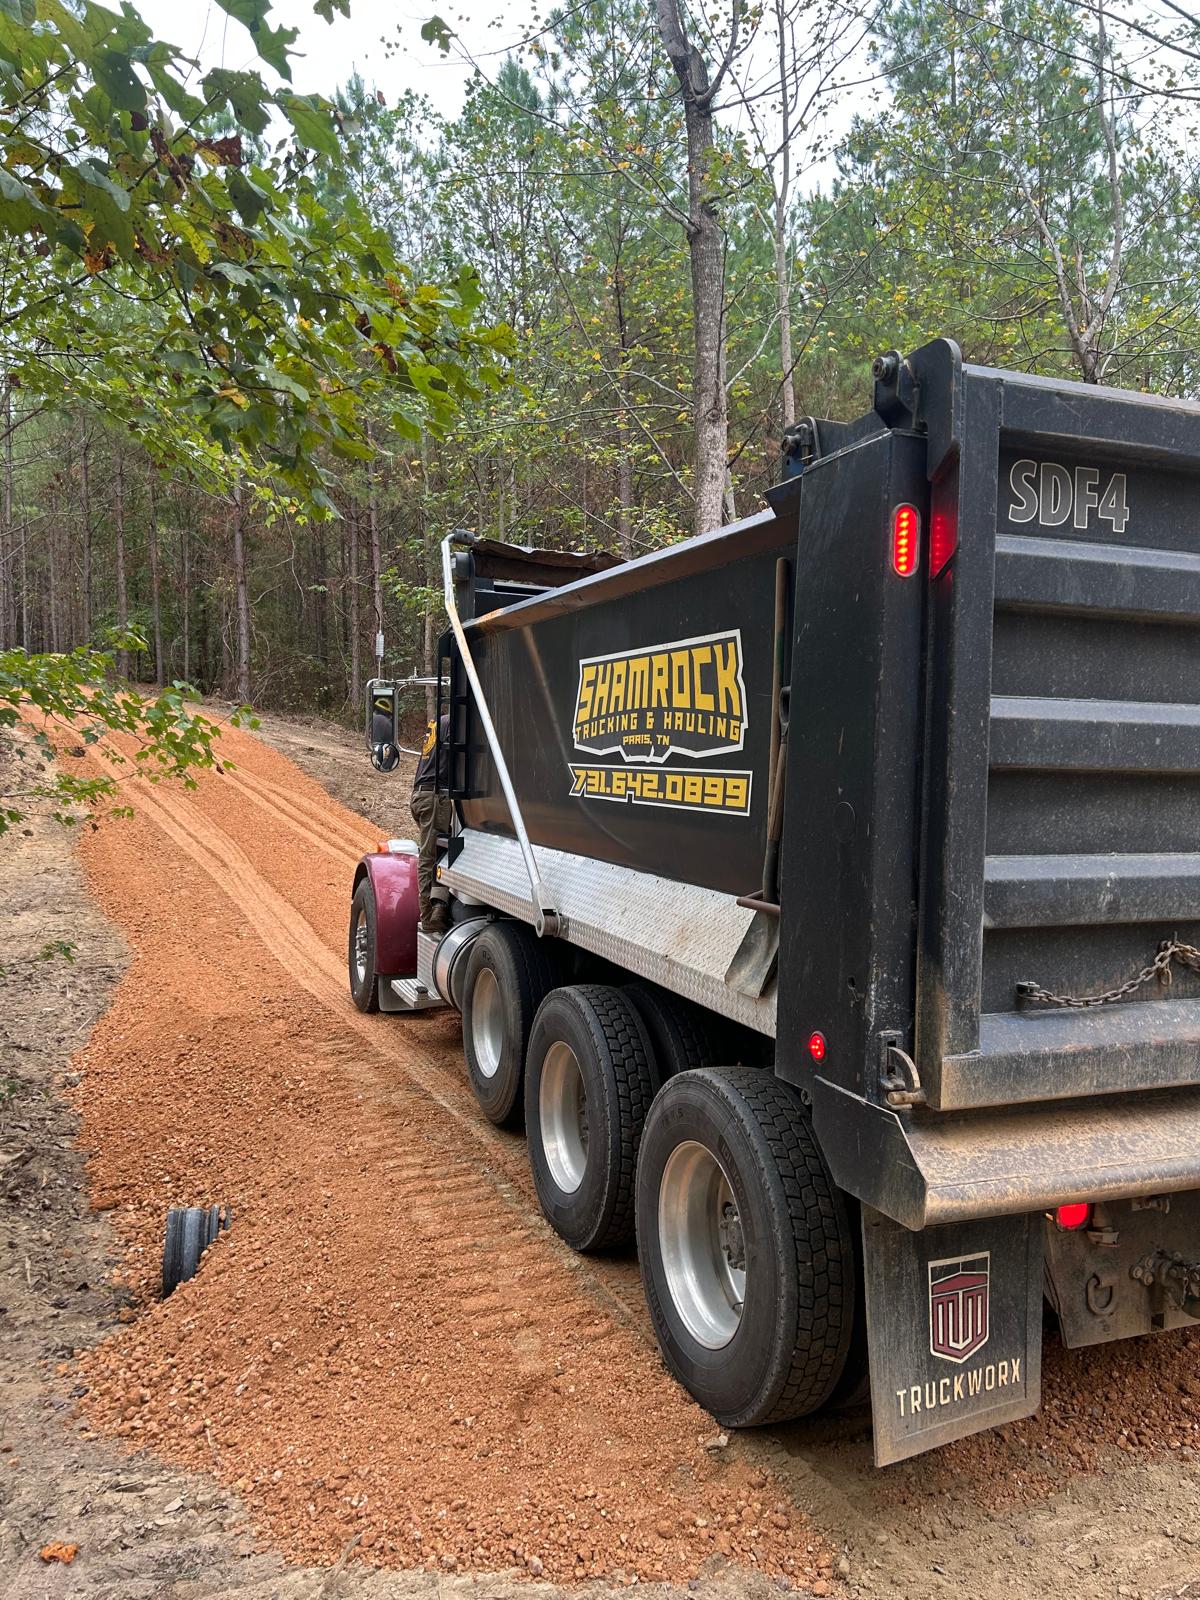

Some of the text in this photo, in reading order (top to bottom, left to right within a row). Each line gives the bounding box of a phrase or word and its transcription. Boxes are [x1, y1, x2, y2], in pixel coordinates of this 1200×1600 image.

[1008, 459, 1130, 533] SDF4
[577, 642, 741, 724] SHAMROCK
[575, 711, 741, 742] TRUCKING & HAULING
[656, 734, 670, 746] TN
[574, 769, 748, 808] 731.642.0899
[896, 1358, 1021, 1417] TRUCKWORX
